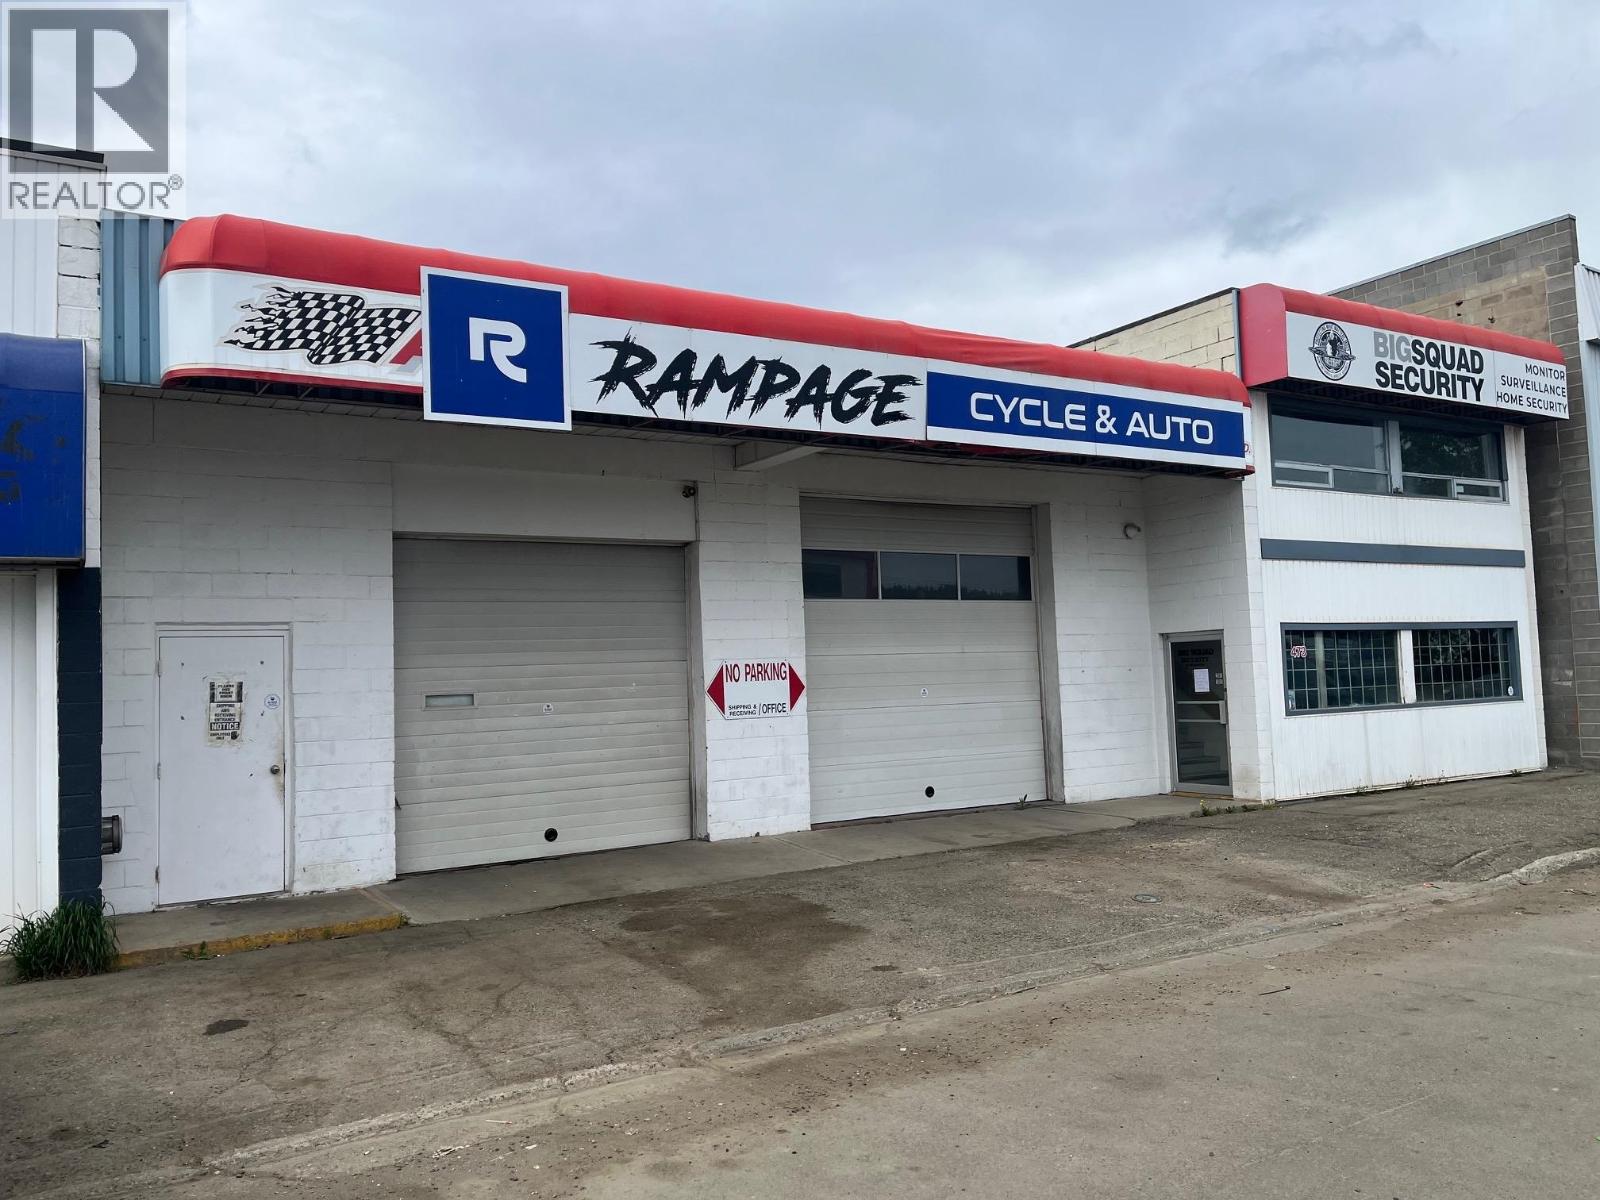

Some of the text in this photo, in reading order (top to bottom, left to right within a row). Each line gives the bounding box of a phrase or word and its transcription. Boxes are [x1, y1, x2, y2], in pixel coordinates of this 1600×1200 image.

[589, 327, 924, 427] RAMPAGE
[1375, 361, 1485, 402] SECURITY
[1525, 363, 1565, 381] MONITOR
[1501, 375, 1566, 397] SURVEILLANCE
[1496, 391, 1568, 414] HOME SECURITY
[970, 392, 1214, 445] CYCLE & AUTO
[725, 661, 787, 683] NO PARKING
[211, 722, 239, 730] NOTICE
